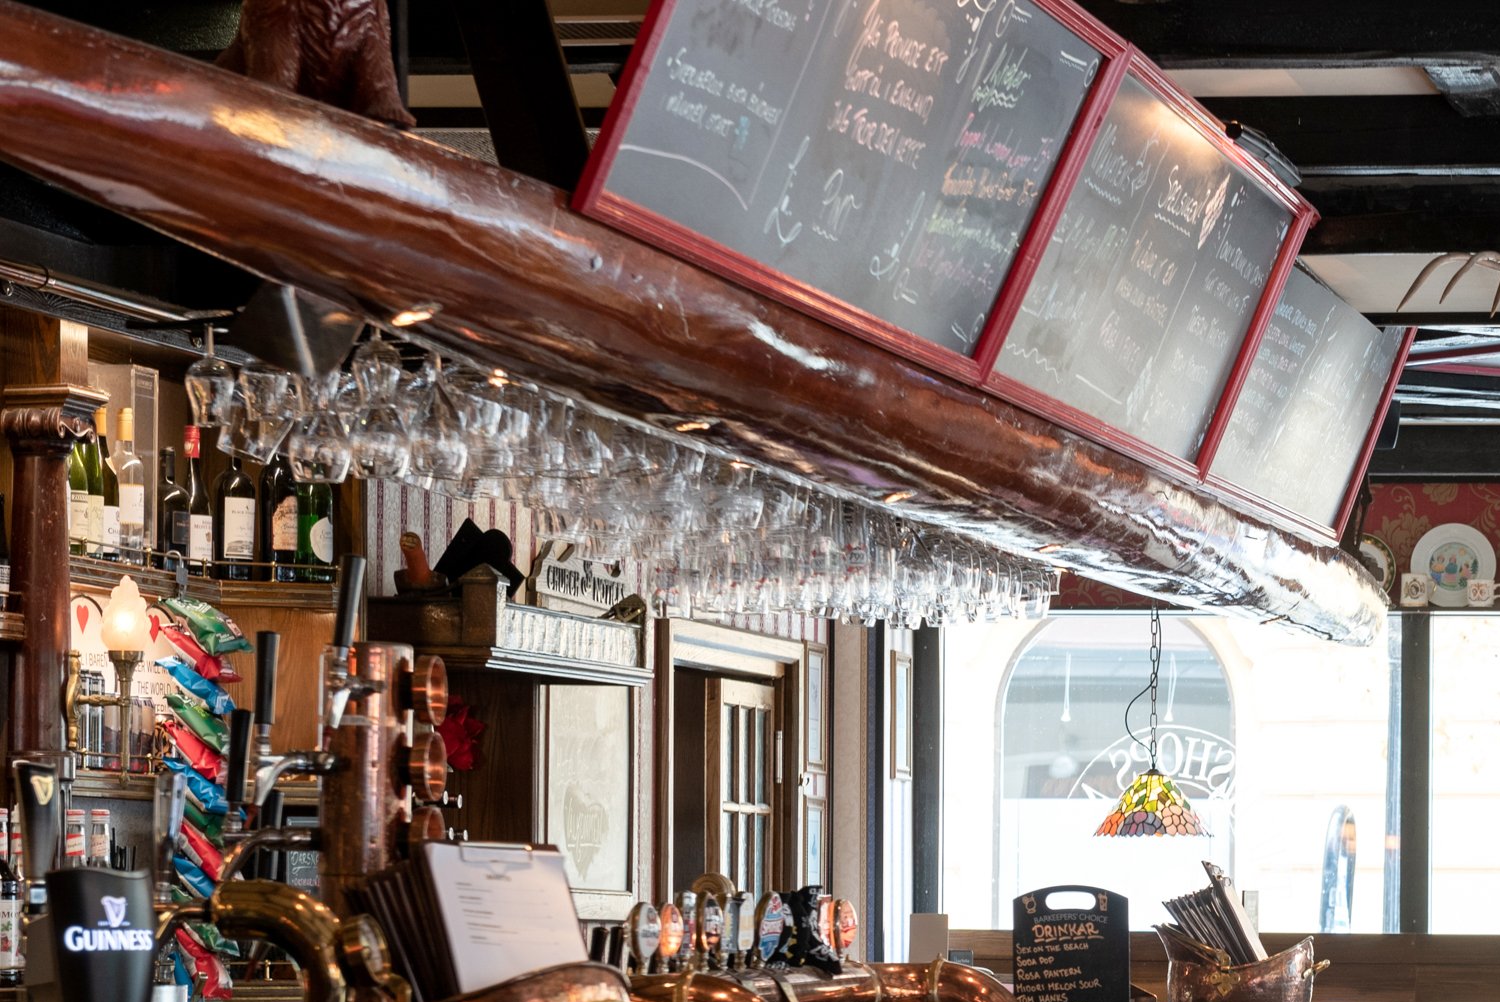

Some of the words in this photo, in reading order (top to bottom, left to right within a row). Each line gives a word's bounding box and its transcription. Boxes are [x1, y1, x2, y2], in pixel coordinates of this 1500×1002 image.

[137, 681, 150, 695] THE
[150, 681, 171, 696] WORLD
[1078, 912, 1108, 923] CHOICE
[1032, 922, 1099, 938] DRINKAR
[63, 925, 153, 951] GUINNESS
[1033, 945, 1043, 953] ON
[1045, 944, 1061, 952] THE
[1063, 942, 1089, 951] BEACH
[1016, 956, 1037, 967] SODA
[1039, 956, 1055, 965] POP
[1016, 968, 1041, 980] ROSA
[1043, 966, 1082, 979] PANTERN
[1048, 981, 1077, 991] MELON
[1079, 978, 1102, 989] SOUR
